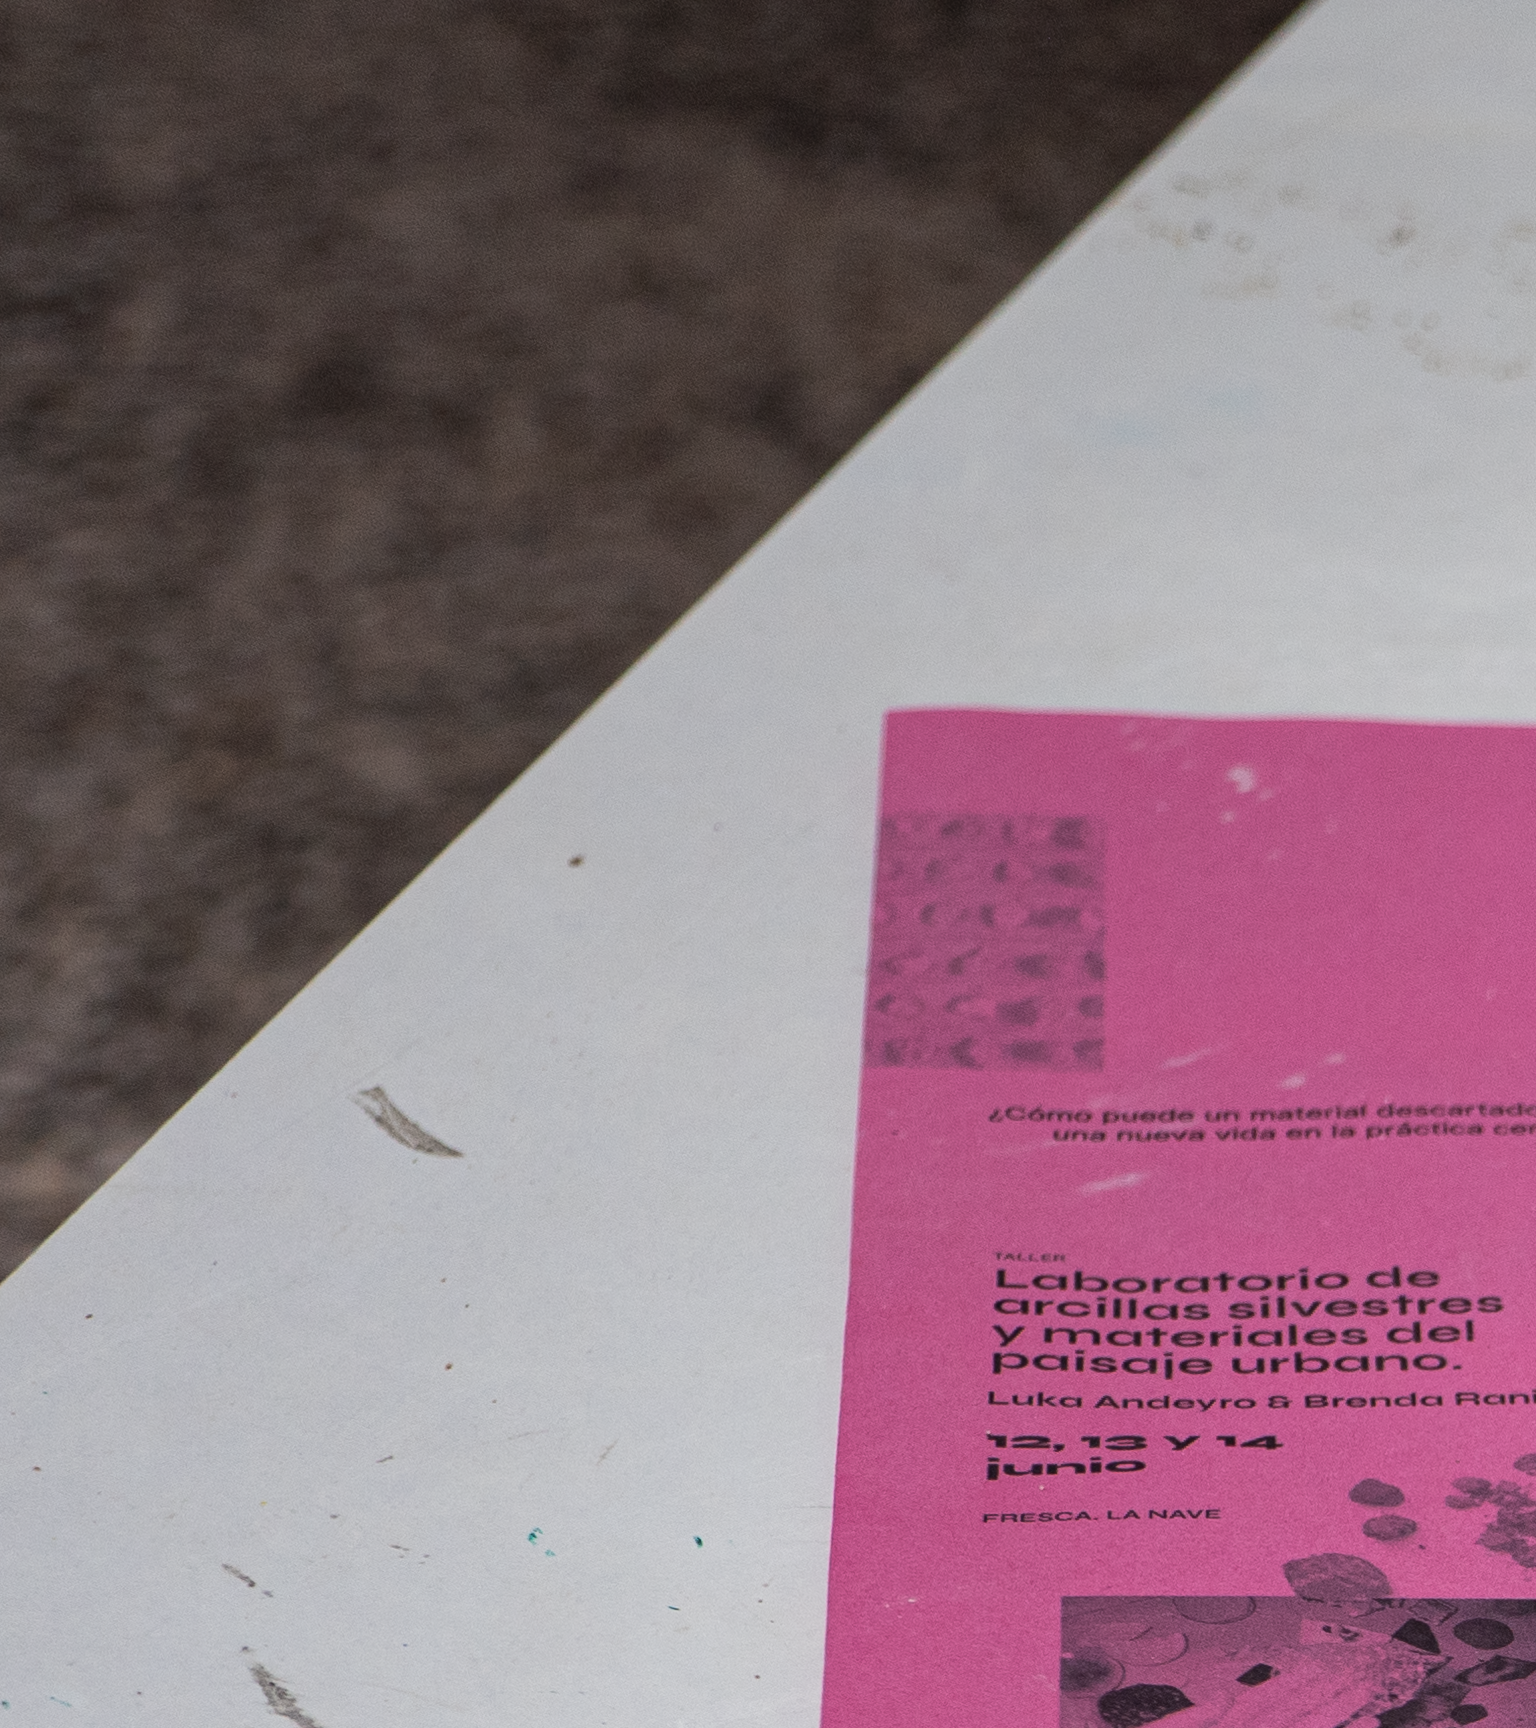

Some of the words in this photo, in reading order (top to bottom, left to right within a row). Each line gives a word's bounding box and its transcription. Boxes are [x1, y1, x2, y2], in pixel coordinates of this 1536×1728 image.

[987, 1103, 1093, 1124] ¿Cómo
[1102, 1106, 1195, 1125] puede
[1204, 1108, 1240, 1123] un
[1249, 1103, 1367, 1123] material
[1052, 1127, 1106, 1143] una
[1116, 1125, 1205, 1143] nueva
[1215, 1124, 1276, 1142] vida
[1285, 1125, 1322, 1141] en
[1331, 1122, 1356, 1140] la
[1365, 1119, 1483, 1140] práctica
[996, 1267, 1350, 1295] Laboratorio
[1365, 1264, 1441, 1289] de
[993, 1295, 1211, 1321] arcillas
[1228, 1292, 1505, 1321] silvestres
[991, 1323, 1026, 1347] y
[1043, 1320, 1370, 1349] materiales
[1386, 1317, 1476, 1344] del
[991, 1347, 1214, 1381] paisaje
[1231, 1349, 1464, 1376] urbano.
[987, 1390, 1083, 1408] Luka
[1094, 1394, 1257, 1413] Andeyro
[1267, 1395, 1293, 1409] &
[1303, 1391, 1444, 1409] Brenda
[986, 1433, 1066, 1453] 12,
[1080, 1434, 1149, 1451] 13
[1216, 1434, 1284, 1450] 14
[986, 1456, 1147, 1481] junio
[981, 1509, 1099, 1524] FRESCA.
[1106, 1508, 1141, 1520] LA
[1148, 1508, 1221, 1520] NAVE
